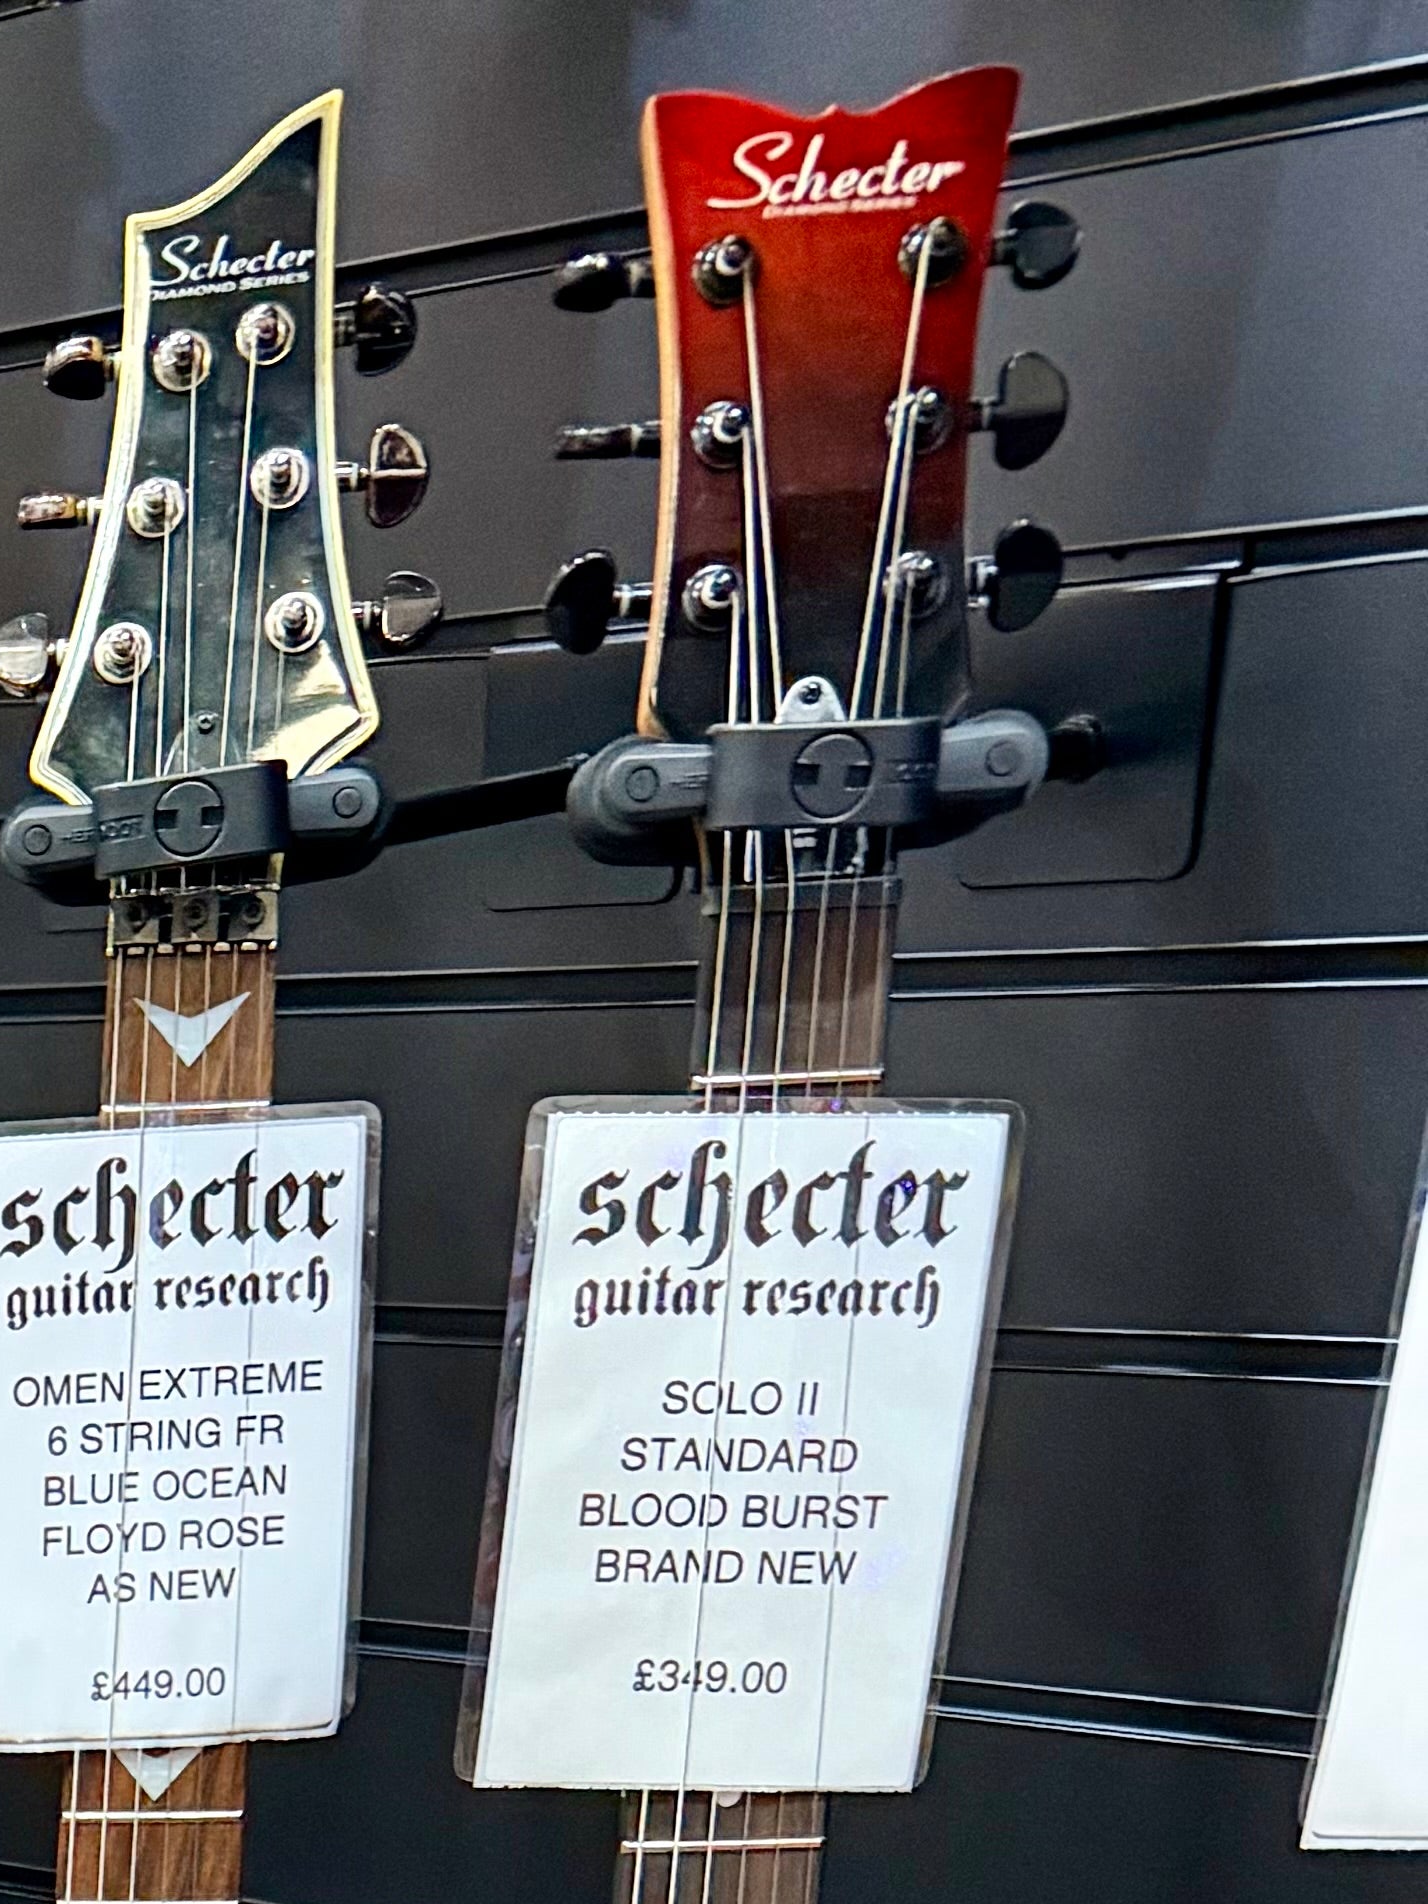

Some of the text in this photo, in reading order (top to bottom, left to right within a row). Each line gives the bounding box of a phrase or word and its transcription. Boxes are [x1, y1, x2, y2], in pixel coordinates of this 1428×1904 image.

[707, 131, 966, 208] Schecter
[150, 234, 315, 286] Schecter
[0, 1149, 346, 1275] schecter
[572, 1139, 972, 1271] schecter
[6, 1256, 331, 1332] guitar research
[573, 1265, 941, 1329] guitar research
[12, 1360, 324, 1408] OMEN EXTREME
[661, 1380, 819, 1417] SOLO II
[47, 1414, 286, 1456] 6 STRING FR
[620, 1437, 860, 1474] STANDARD
[43, 1464, 289, 1507] BLUE OCEAN
[578, 1493, 889, 1530] BLOOD BURST
[42, 1515, 286, 1558] FLOYD ROSE
[86, 1566, 238, 1605] AS NEW
[594, 1548, 858, 1586] BRAND NEW
[90, 1667, 228, 1703] £449.00
[631, 1658, 789, 1695] £349.00
